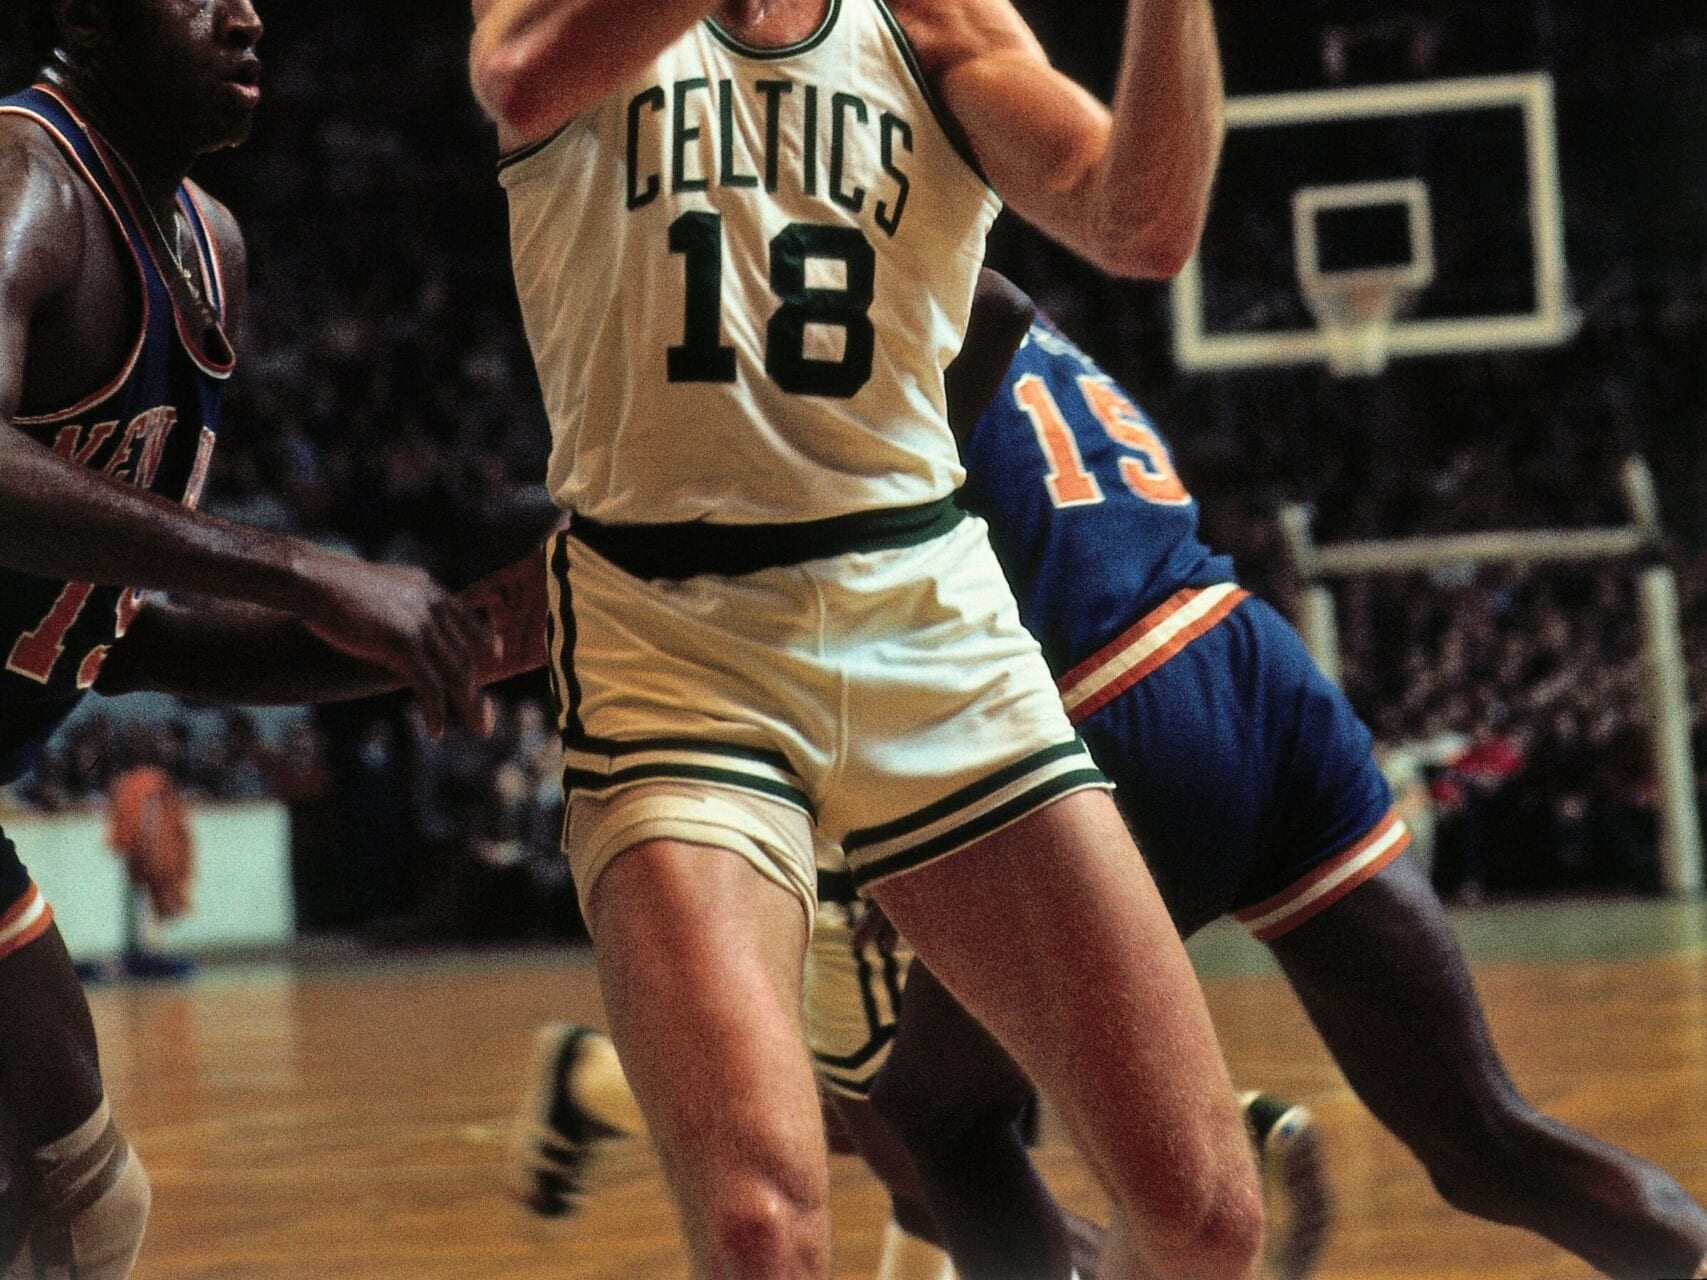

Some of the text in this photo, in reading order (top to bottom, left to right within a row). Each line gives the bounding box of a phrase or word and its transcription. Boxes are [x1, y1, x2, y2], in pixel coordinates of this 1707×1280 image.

[626, 77, 913, 238] CELTICS
[666, 211, 876, 399] 18
[1013, 372, 1192, 509] 15
